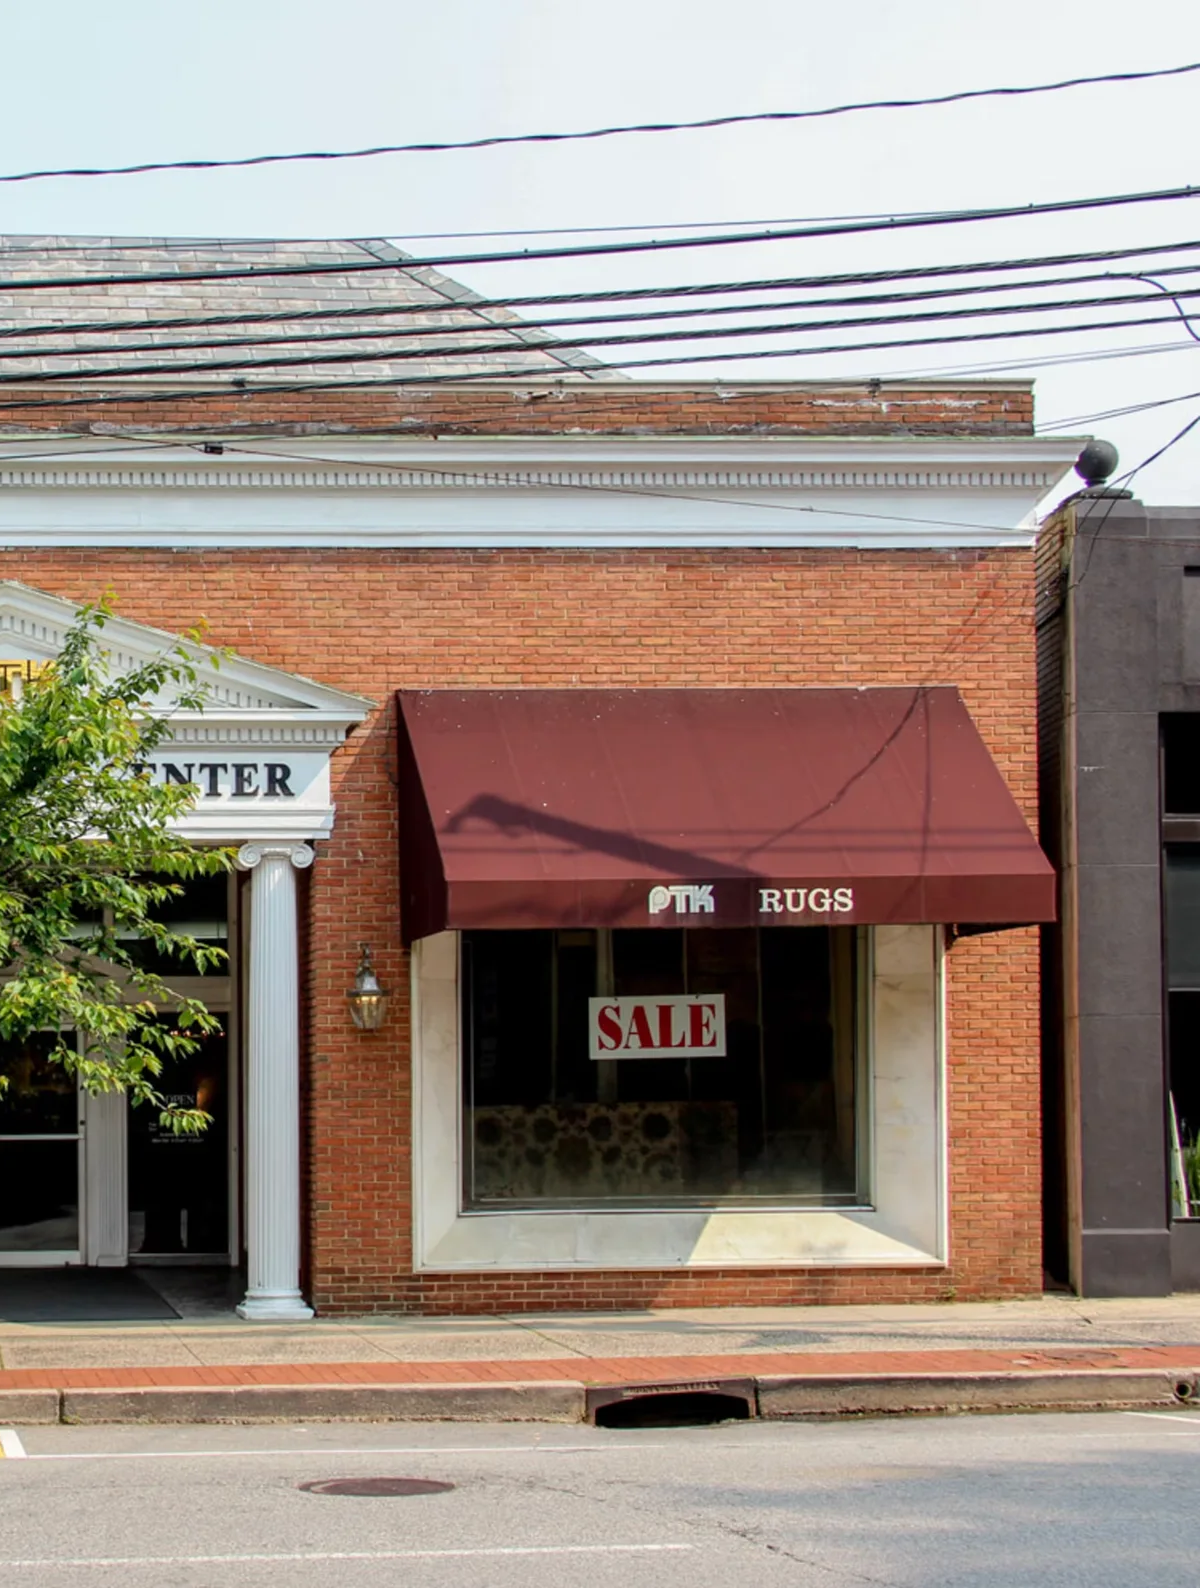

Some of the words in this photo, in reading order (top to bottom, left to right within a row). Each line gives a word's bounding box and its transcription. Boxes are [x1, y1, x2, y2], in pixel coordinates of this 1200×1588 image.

[103, 762, 295, 797] NTER
[649, 885, 715, 913] PTK
[758, 888, 853, 912] RUGS
[597, 1004, 717, 1051] SALE
